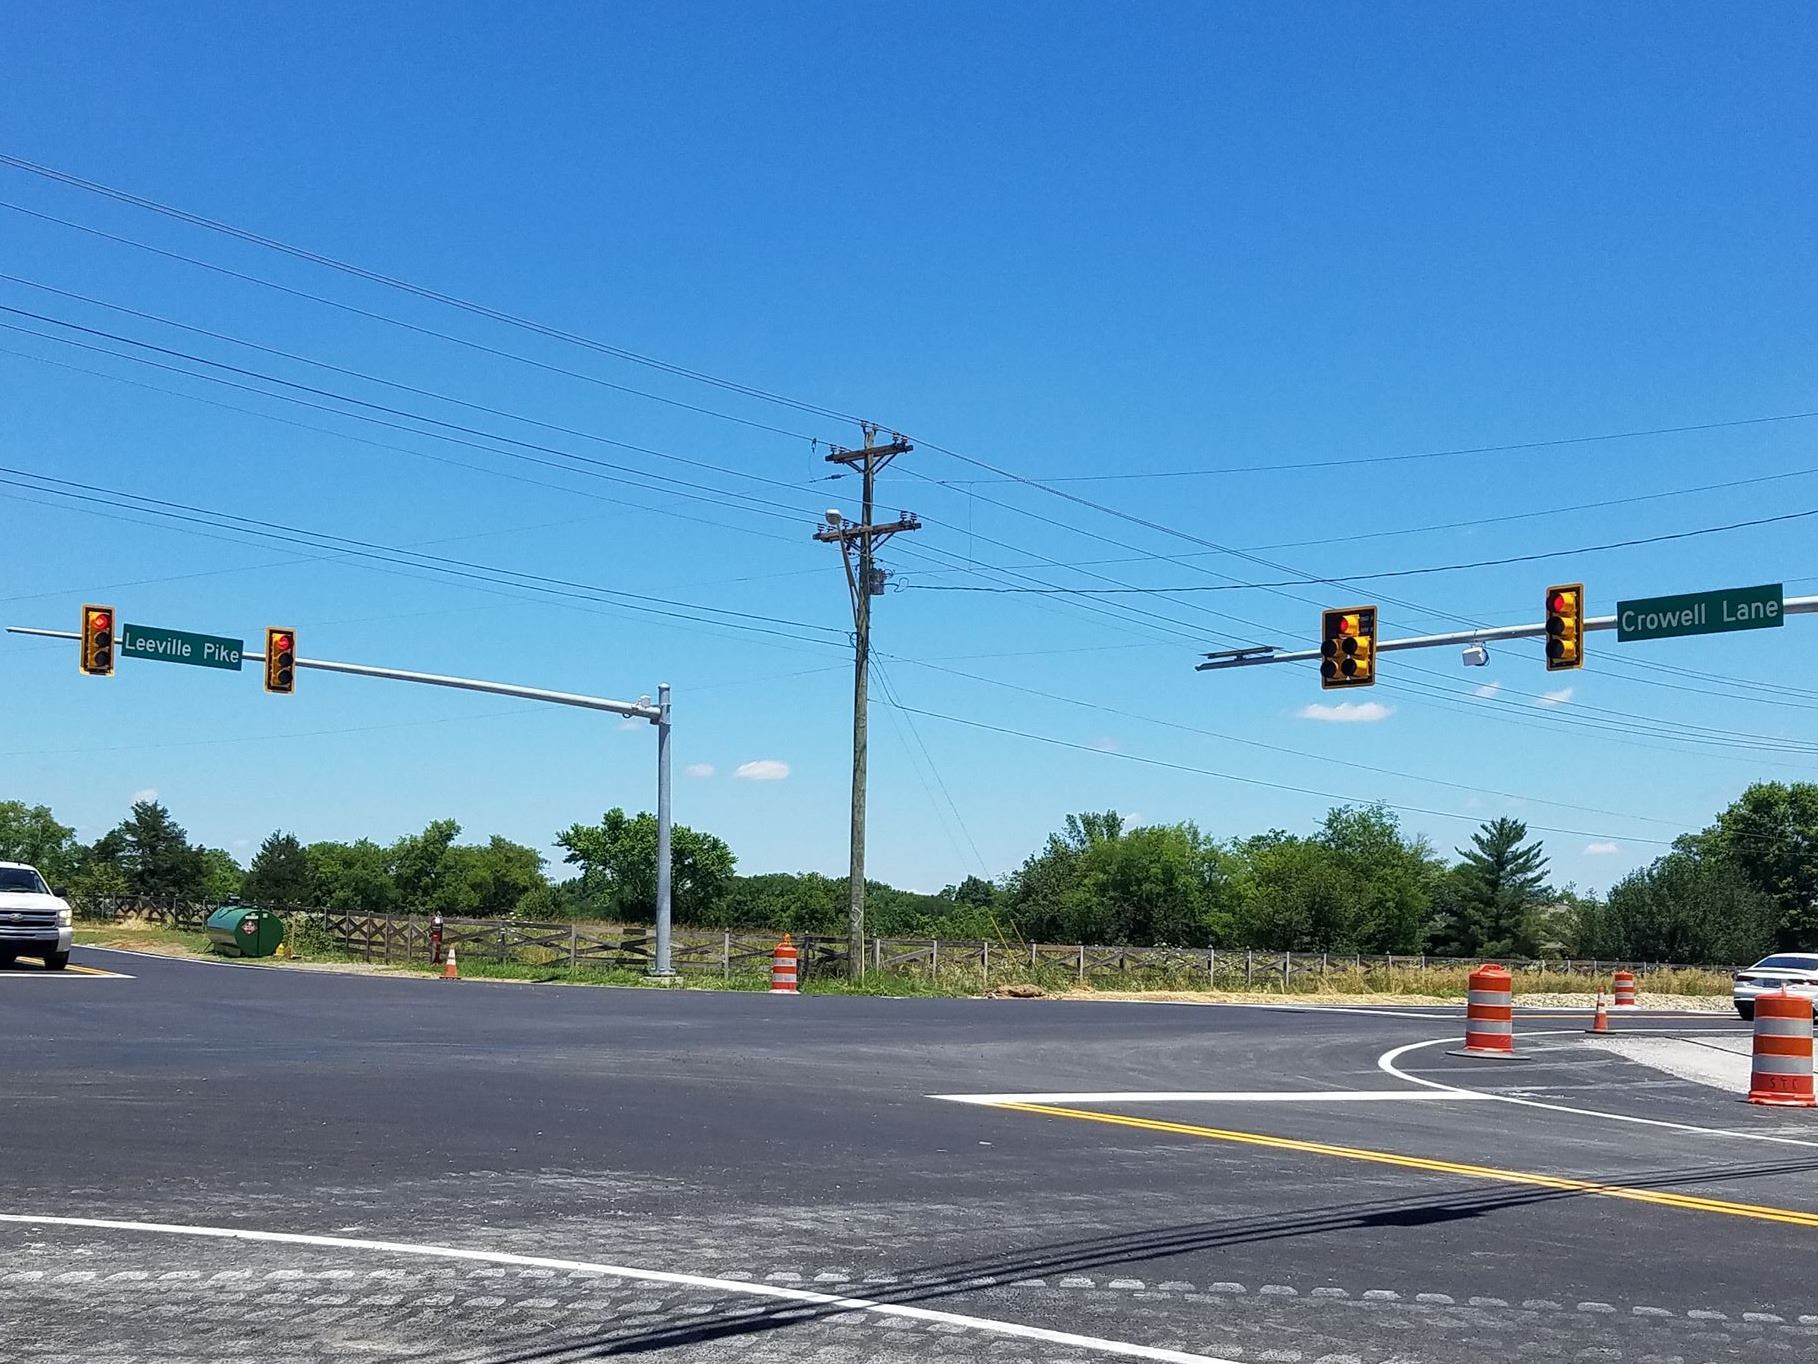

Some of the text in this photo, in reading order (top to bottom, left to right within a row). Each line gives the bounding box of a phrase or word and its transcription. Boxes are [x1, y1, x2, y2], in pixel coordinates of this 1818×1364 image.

[1622, 600, 1779, 632] Crowell Lane
[125, 632, 240, 663] Leeville Pike
